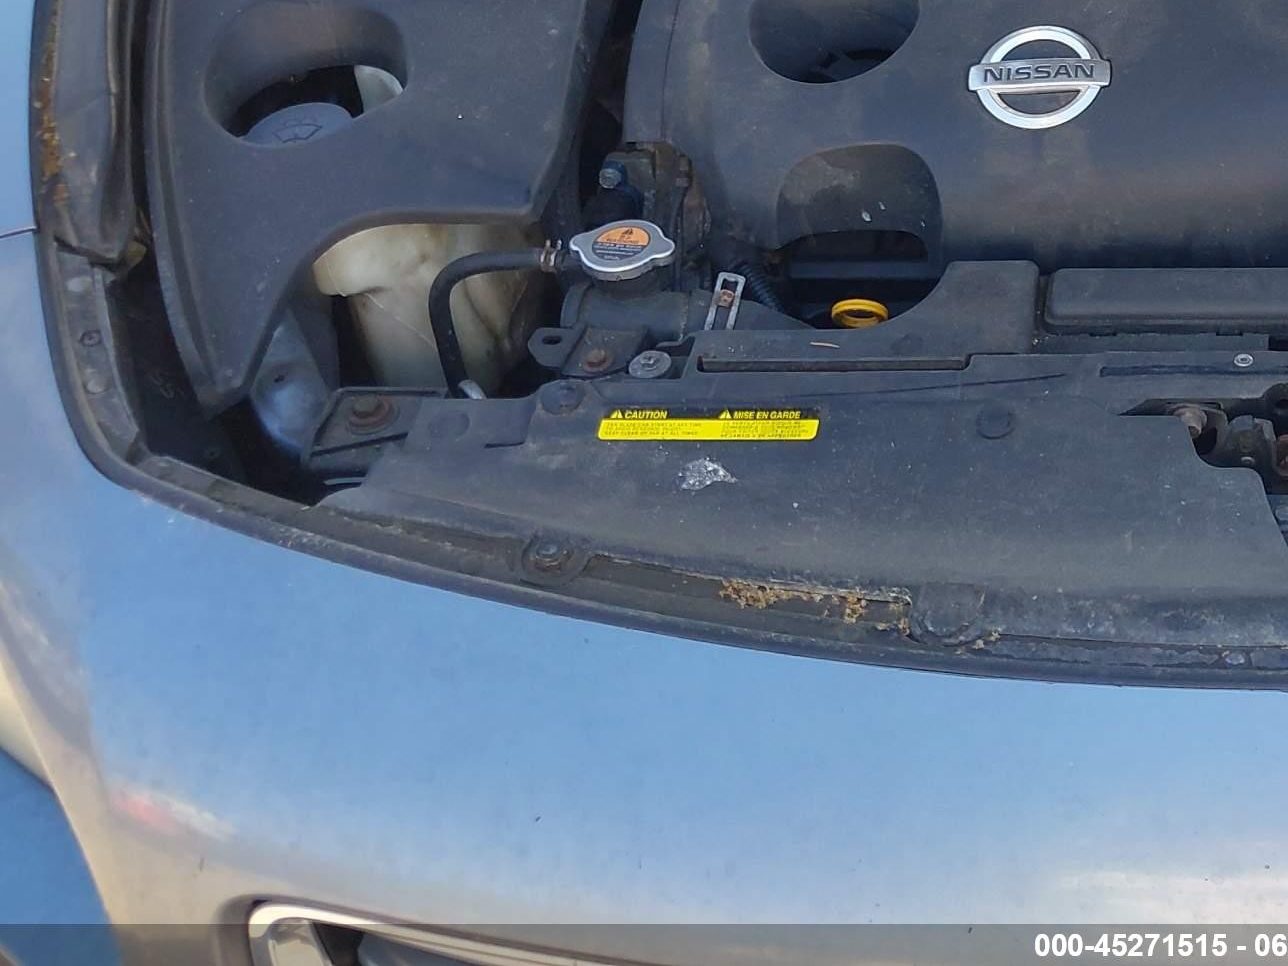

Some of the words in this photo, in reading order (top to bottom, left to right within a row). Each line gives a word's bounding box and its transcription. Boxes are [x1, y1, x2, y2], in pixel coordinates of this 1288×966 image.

[983, 63, 1095, 83] NISSAN
[624, 410, 668, 419] CAUTION
[733, 410, 755, 419] MISE
[756, 410, 769, 419] EN
[770, 410, 802, 419] GARDE
